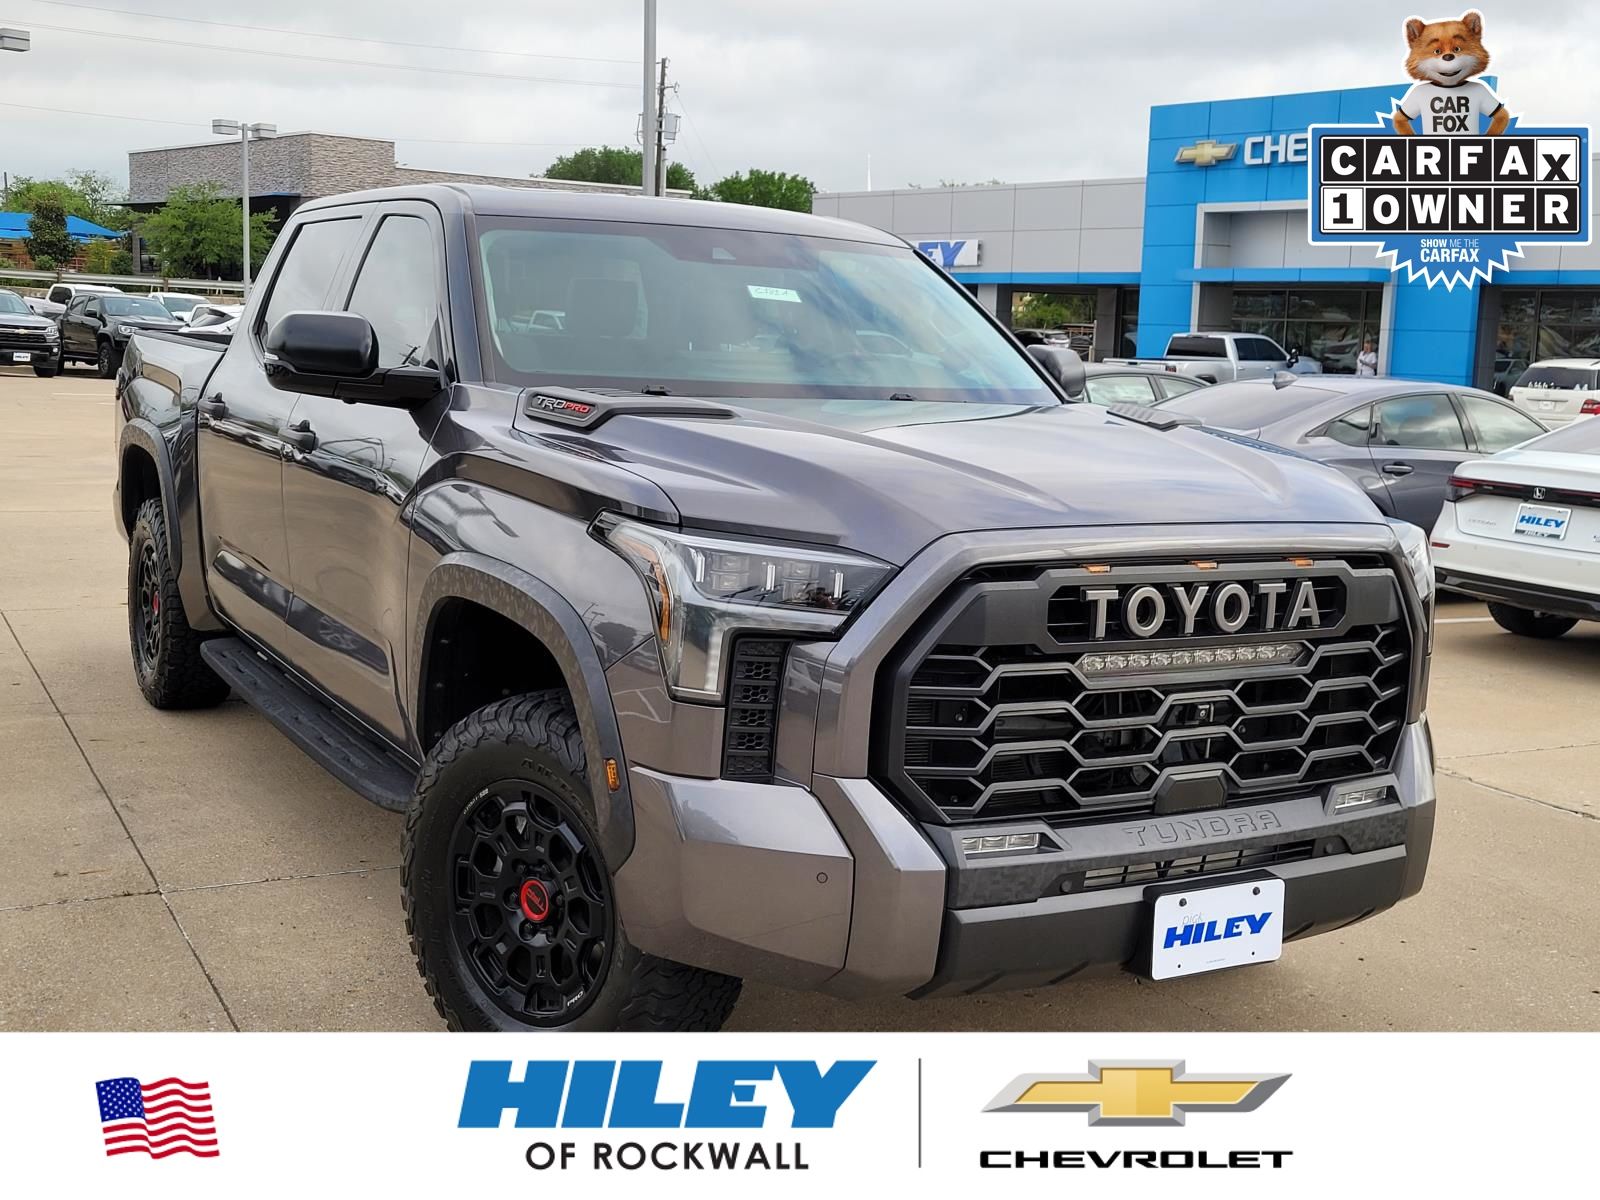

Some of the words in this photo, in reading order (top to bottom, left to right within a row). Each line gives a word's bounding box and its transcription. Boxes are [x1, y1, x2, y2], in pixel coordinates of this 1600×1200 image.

[1244, 133, 1309, 165] CHE
[1519, 515, 1566, 528] HILEY
[1081, 579, 1320, 640] TOYOTA
[1121, 809, 1282, 847] TUNDRA
[1163, 911, 1273, 950] HILEY
